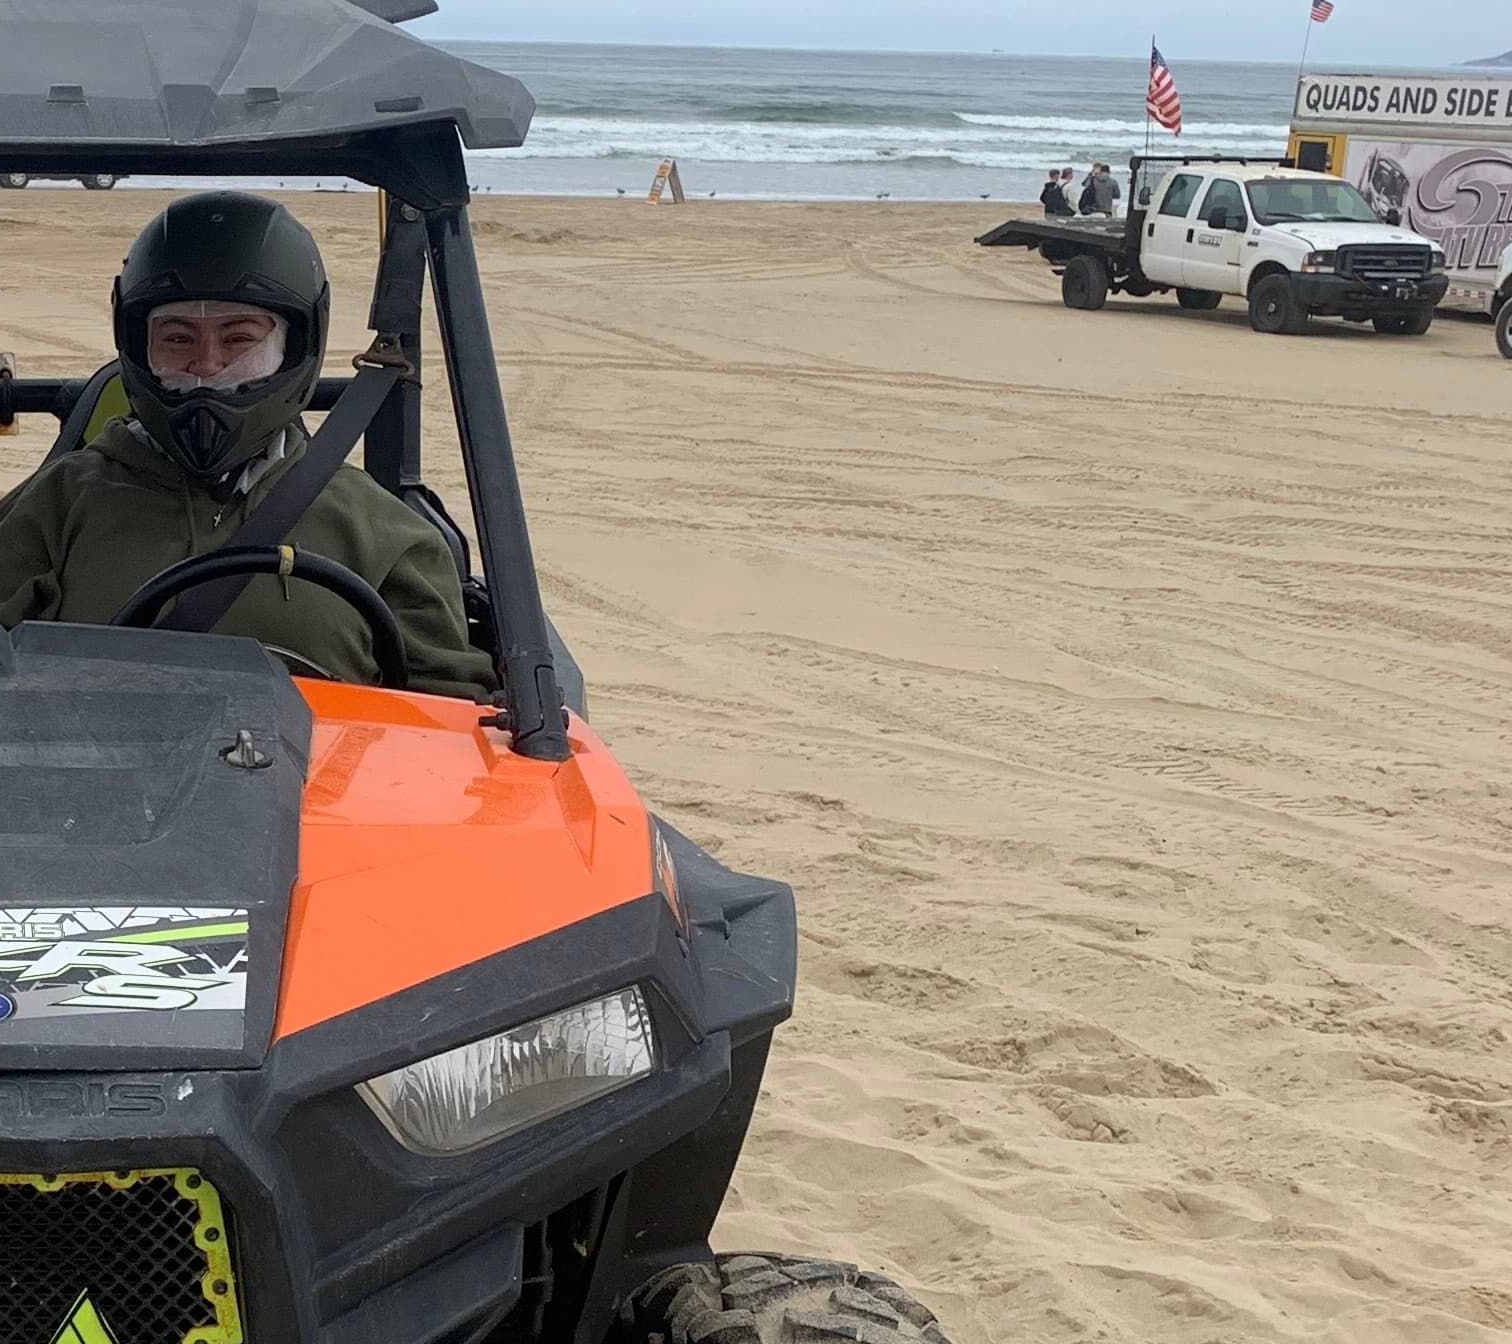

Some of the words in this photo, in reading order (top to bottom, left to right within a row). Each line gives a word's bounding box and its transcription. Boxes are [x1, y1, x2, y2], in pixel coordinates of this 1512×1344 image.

[1305, 83, 1380, 113] QUADS
[1384, 86, 1438, 115] AND
[1443, 87, 1500, 118] SIDE
